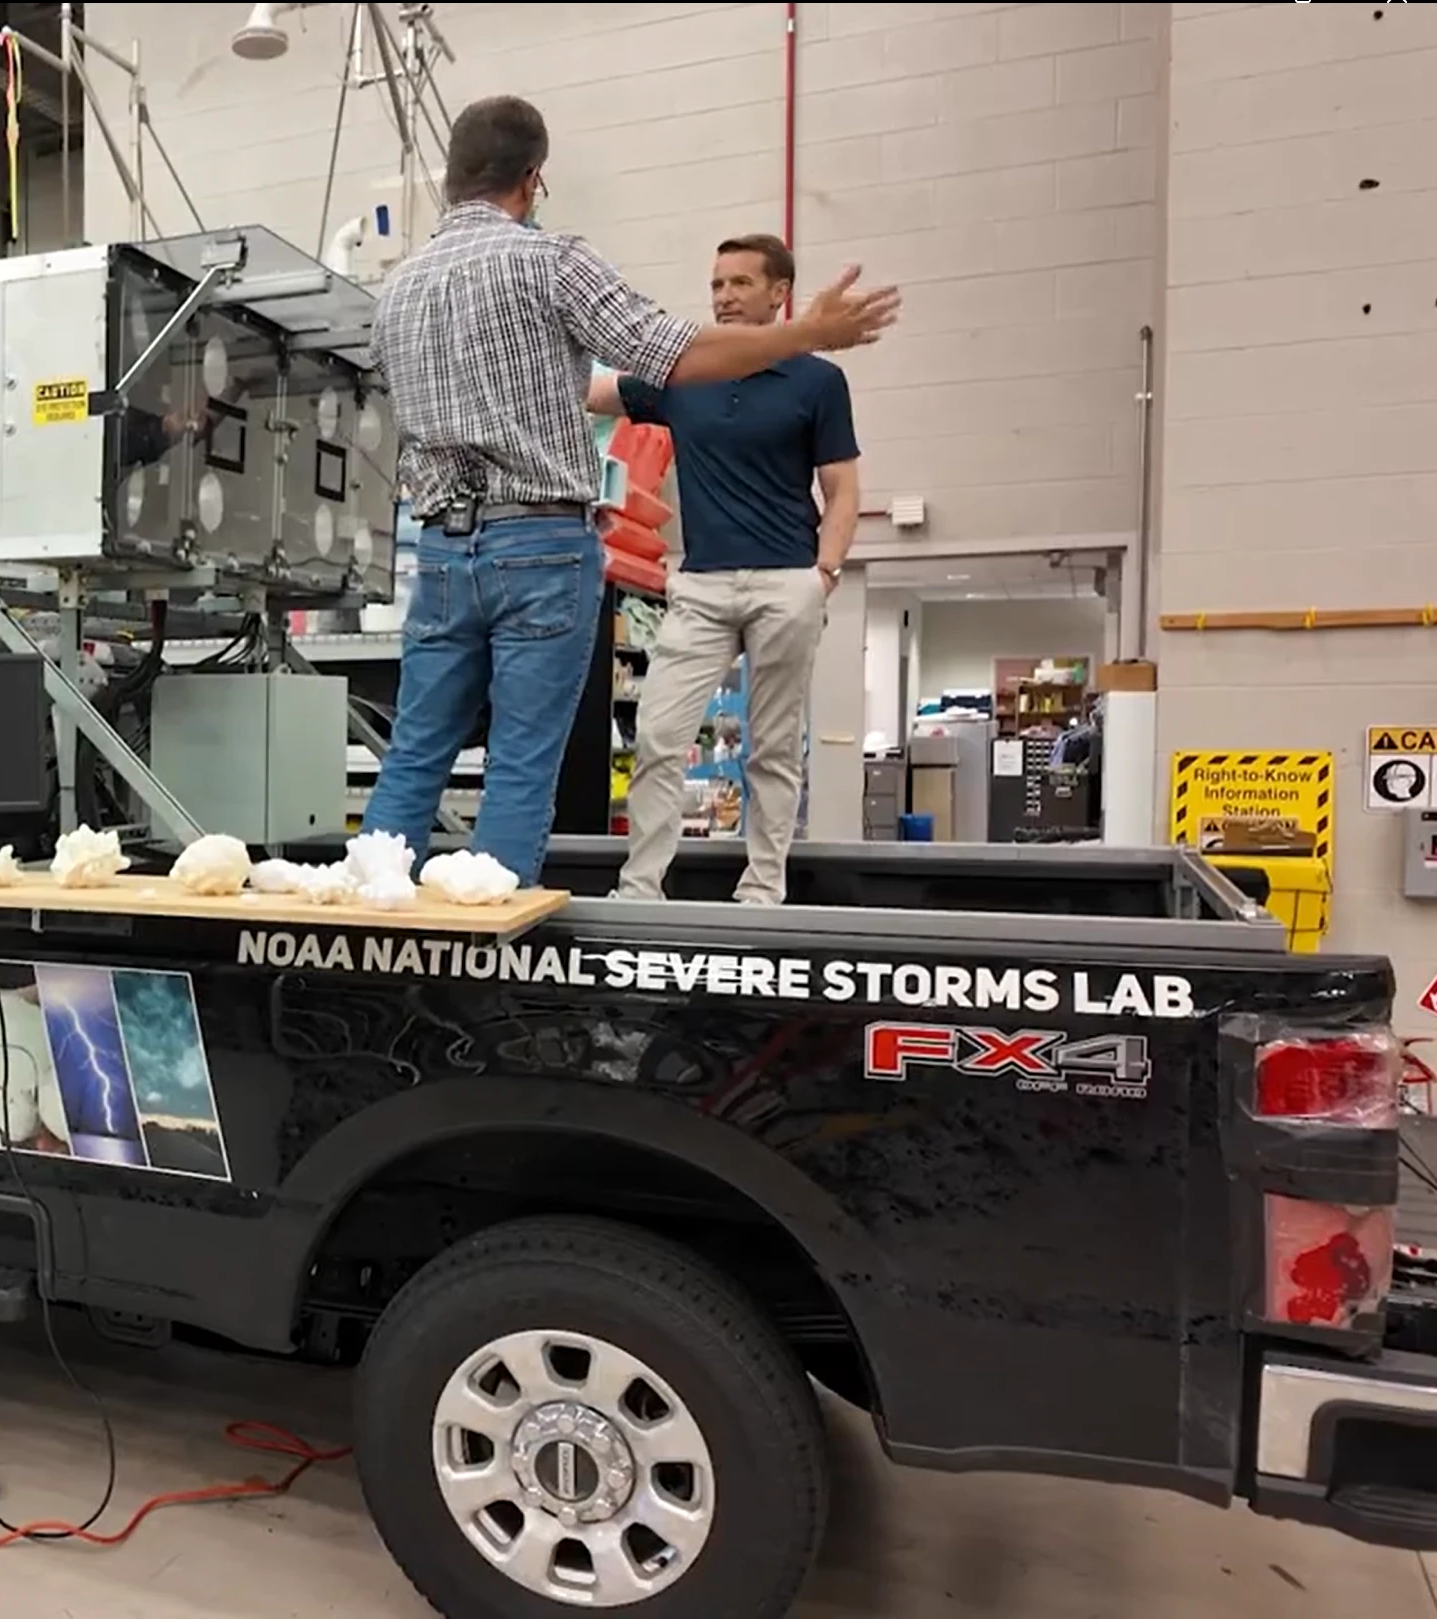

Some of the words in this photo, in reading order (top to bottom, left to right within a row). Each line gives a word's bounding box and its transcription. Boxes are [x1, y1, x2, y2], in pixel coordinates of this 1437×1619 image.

[37, 384, 85, 399] CAUTION
[1193, 768, 1313, 785] Right-to-Know
[1204, 786, 1300, 801] Information
[1222, 803, 1281, 817] Station
[237, 930, 354, 970] NOAA
[362, 936, 595, 986] NATIONAL
[604, 949, 811, 999] SEVERE
[822, 960, 1059, 1012] STORMS
[1073, 971, 1194, 1018] LAB
[865, 1020, 1151, 1086] FX4
